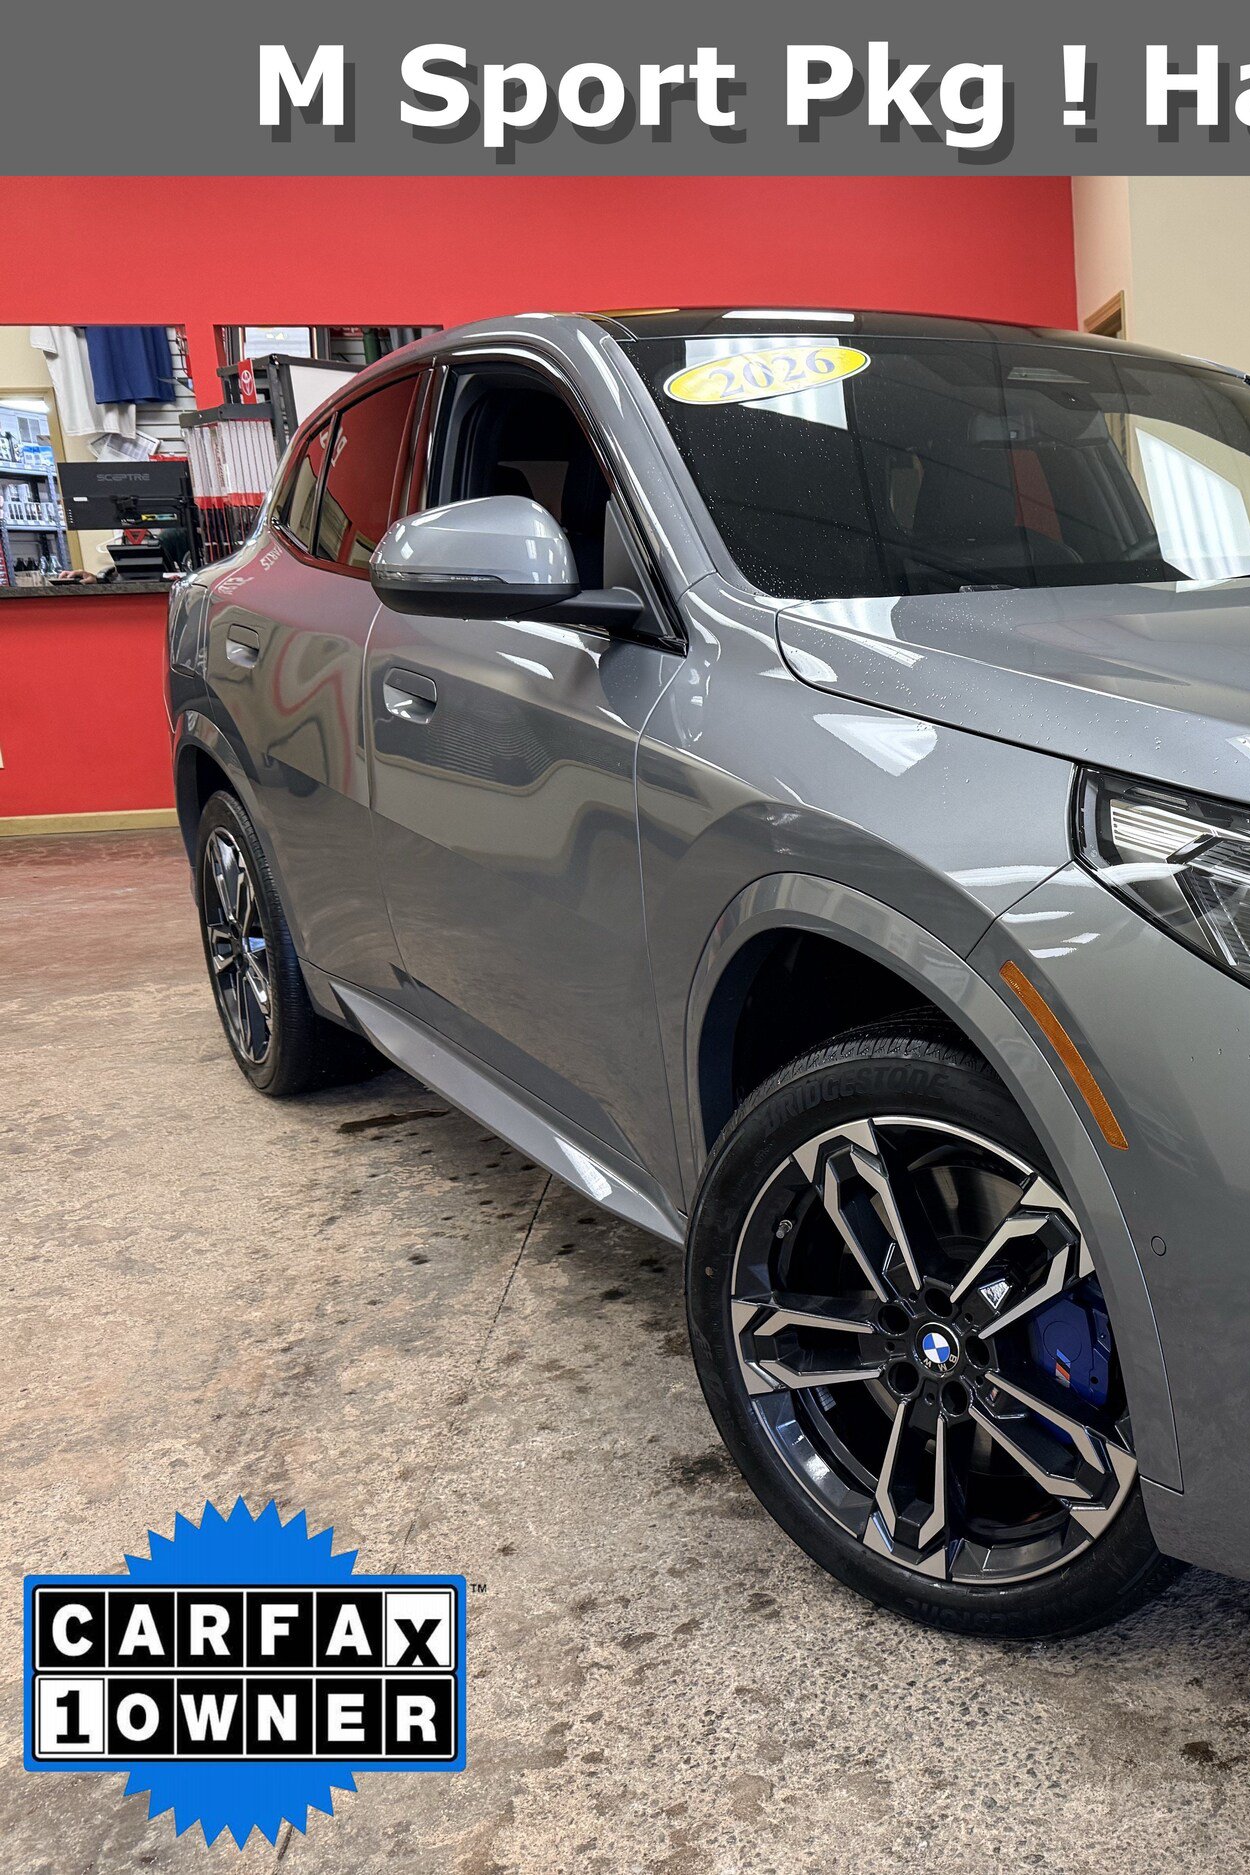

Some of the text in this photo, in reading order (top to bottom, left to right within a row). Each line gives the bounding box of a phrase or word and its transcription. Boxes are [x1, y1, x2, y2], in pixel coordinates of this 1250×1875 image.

[708, 349, 836, 398] 2026
[96, 473, 151, 482] SCEPTRE
[923, 1353, 958, 1373] BMW
